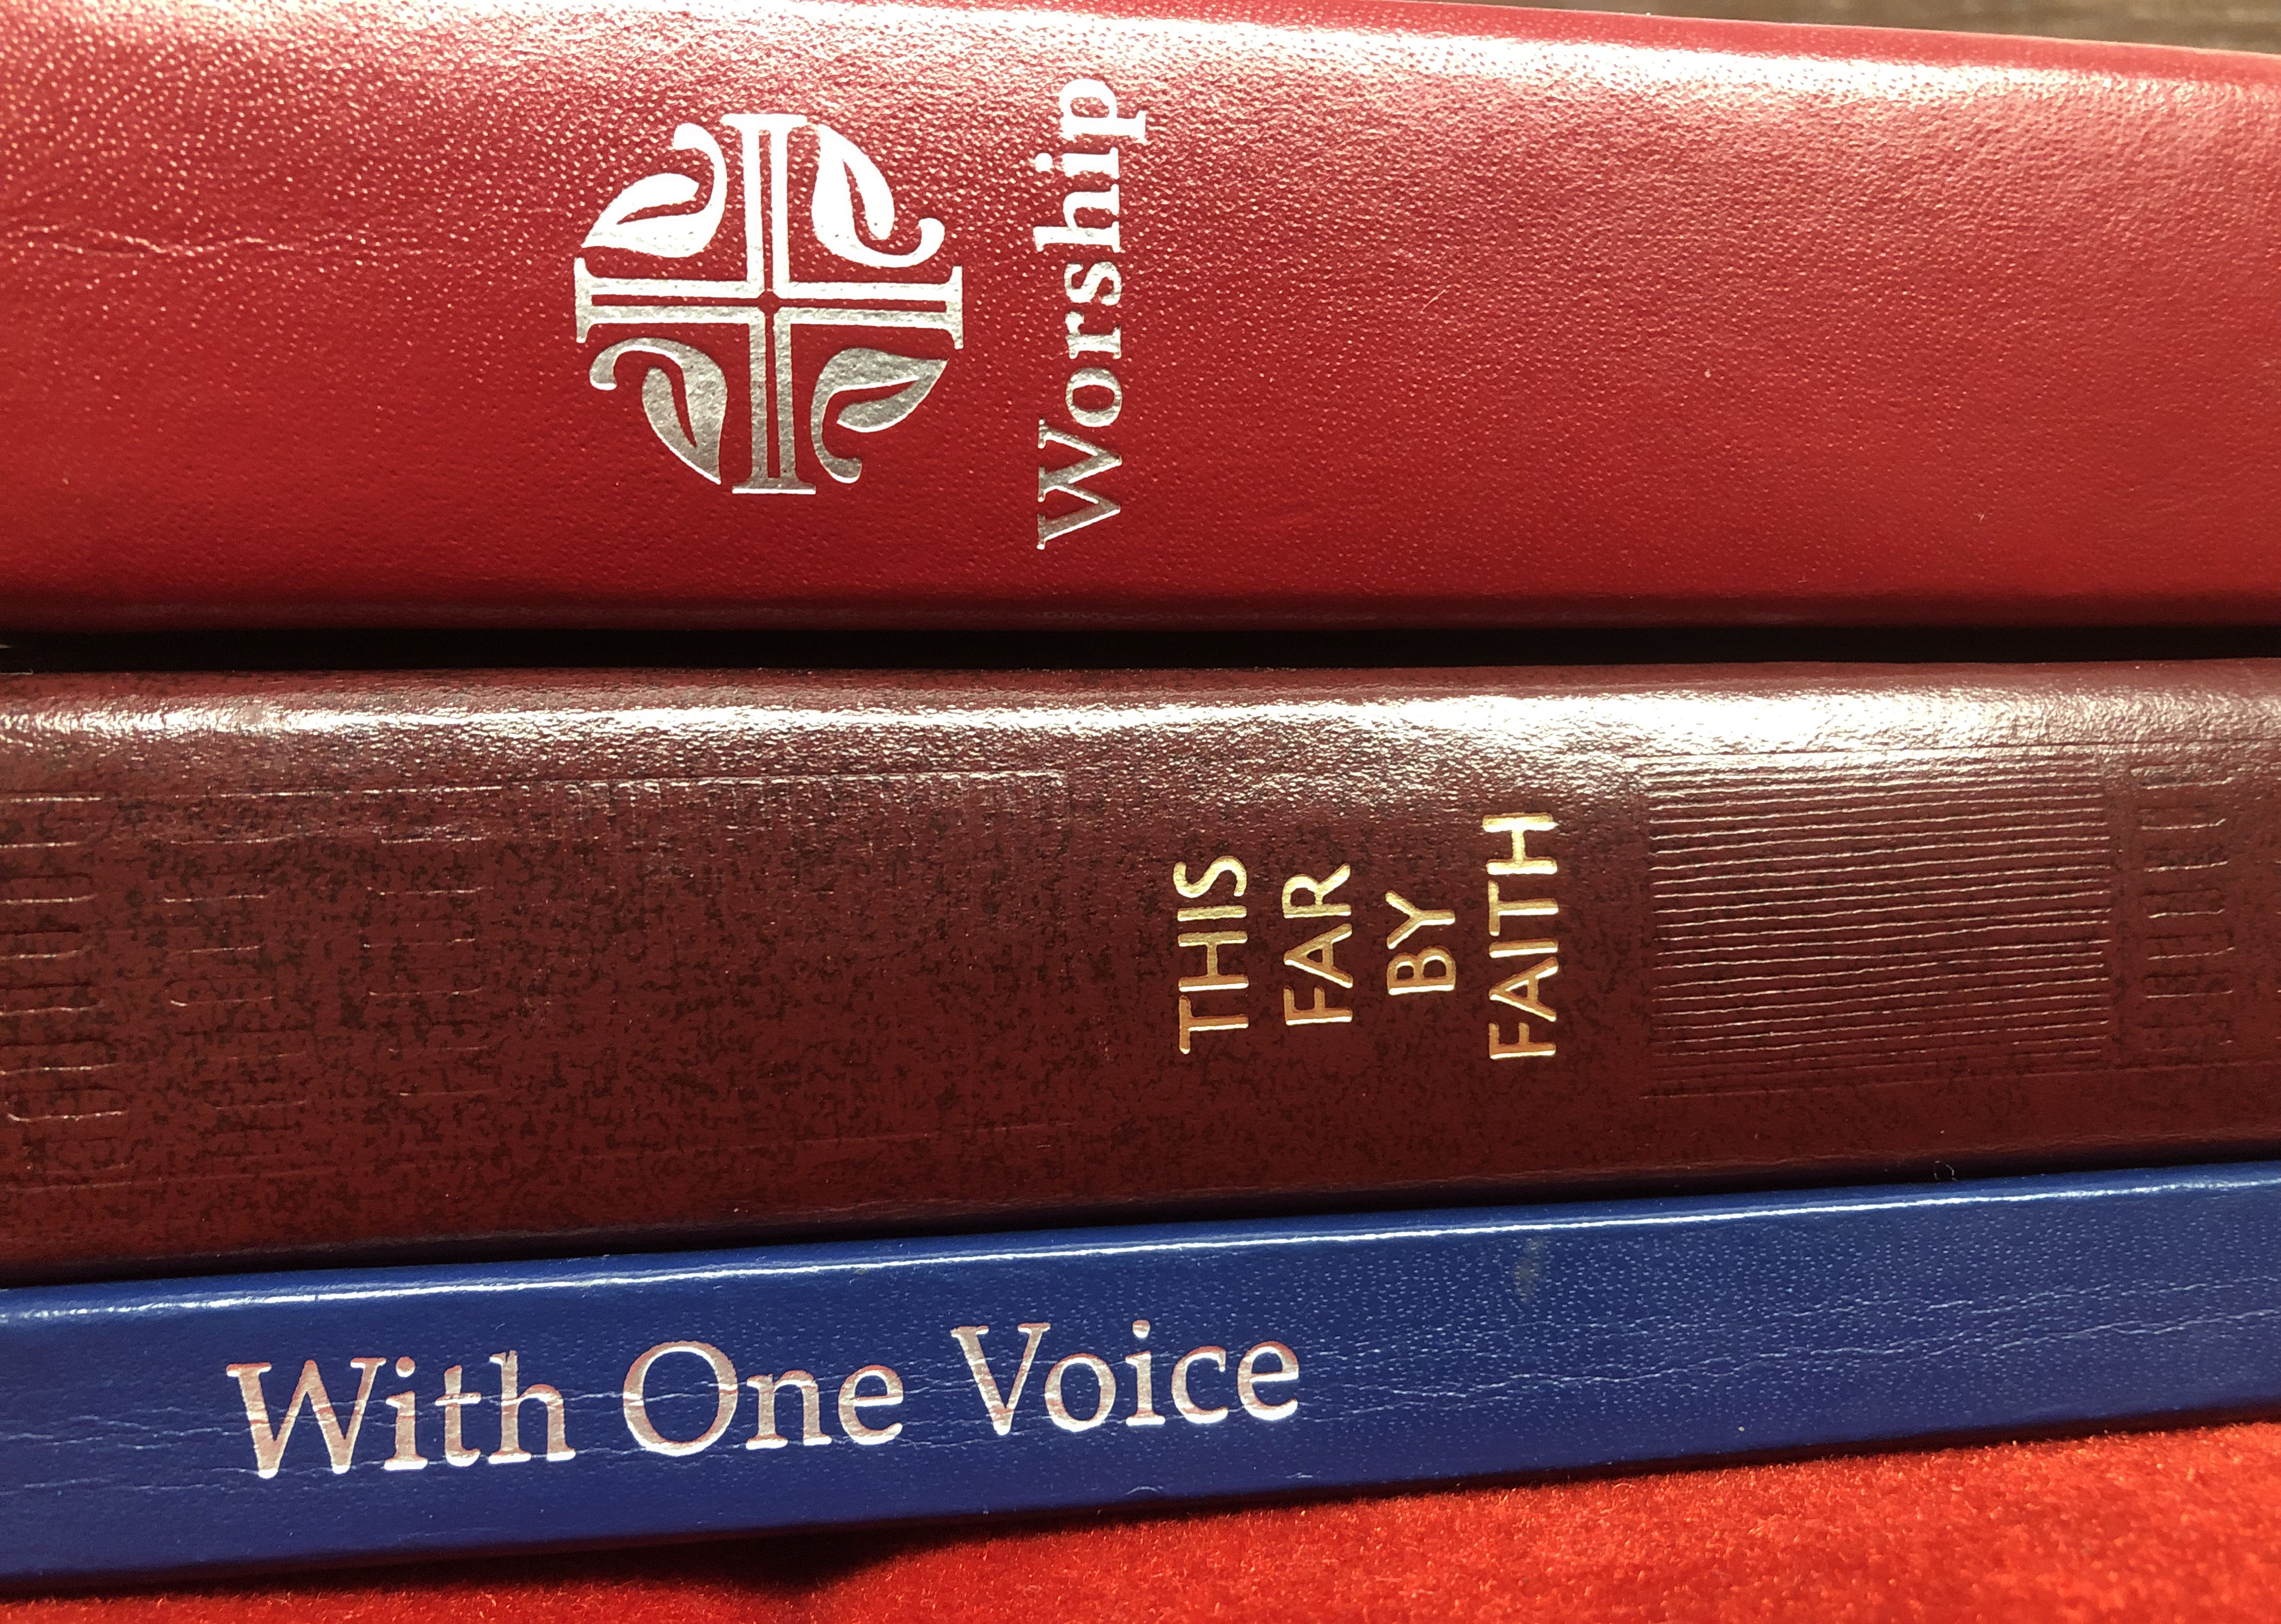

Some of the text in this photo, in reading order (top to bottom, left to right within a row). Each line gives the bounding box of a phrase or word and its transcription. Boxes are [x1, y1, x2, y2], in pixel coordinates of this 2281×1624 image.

[1033, 77, 1147, 550] Worship
[1173, 855, 1249, 1054] THIS
[1281, 863, 1354, 1026] FAR
[1385, 890, 1456, 996] BY
[1482, 812, 1560, 1060] FAITH
[226, 1319, 1300, 1479] With One Voice
